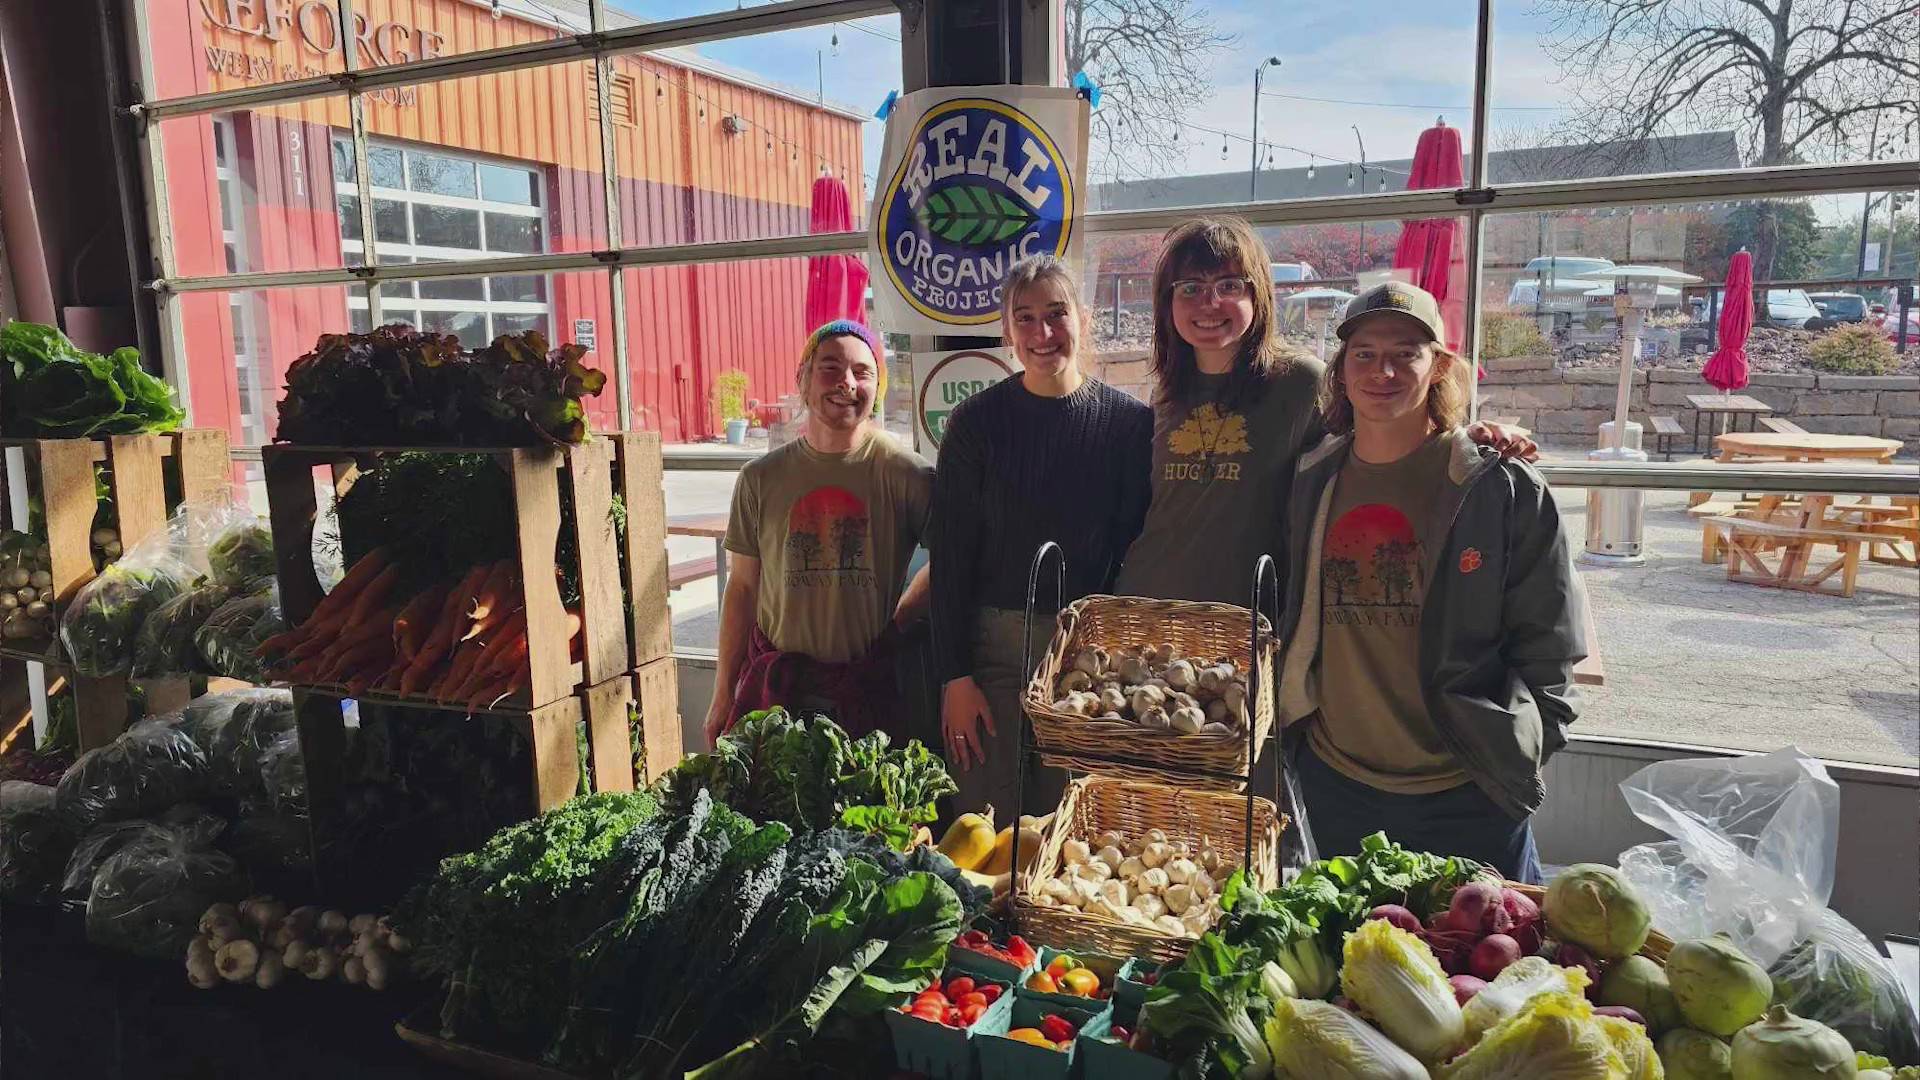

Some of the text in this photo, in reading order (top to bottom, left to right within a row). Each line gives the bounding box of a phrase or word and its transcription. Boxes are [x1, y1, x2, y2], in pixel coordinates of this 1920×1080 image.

[290, 131, 305, 196] 311
[901, 114, 1052, 210] REAL
[895, 230, 1041, 288] ORGANIC
[911, 274, 1004, 311] PROJEC
[942, 379, 997, 405] USD
[1164, 462, 1242, 481] HUGER
